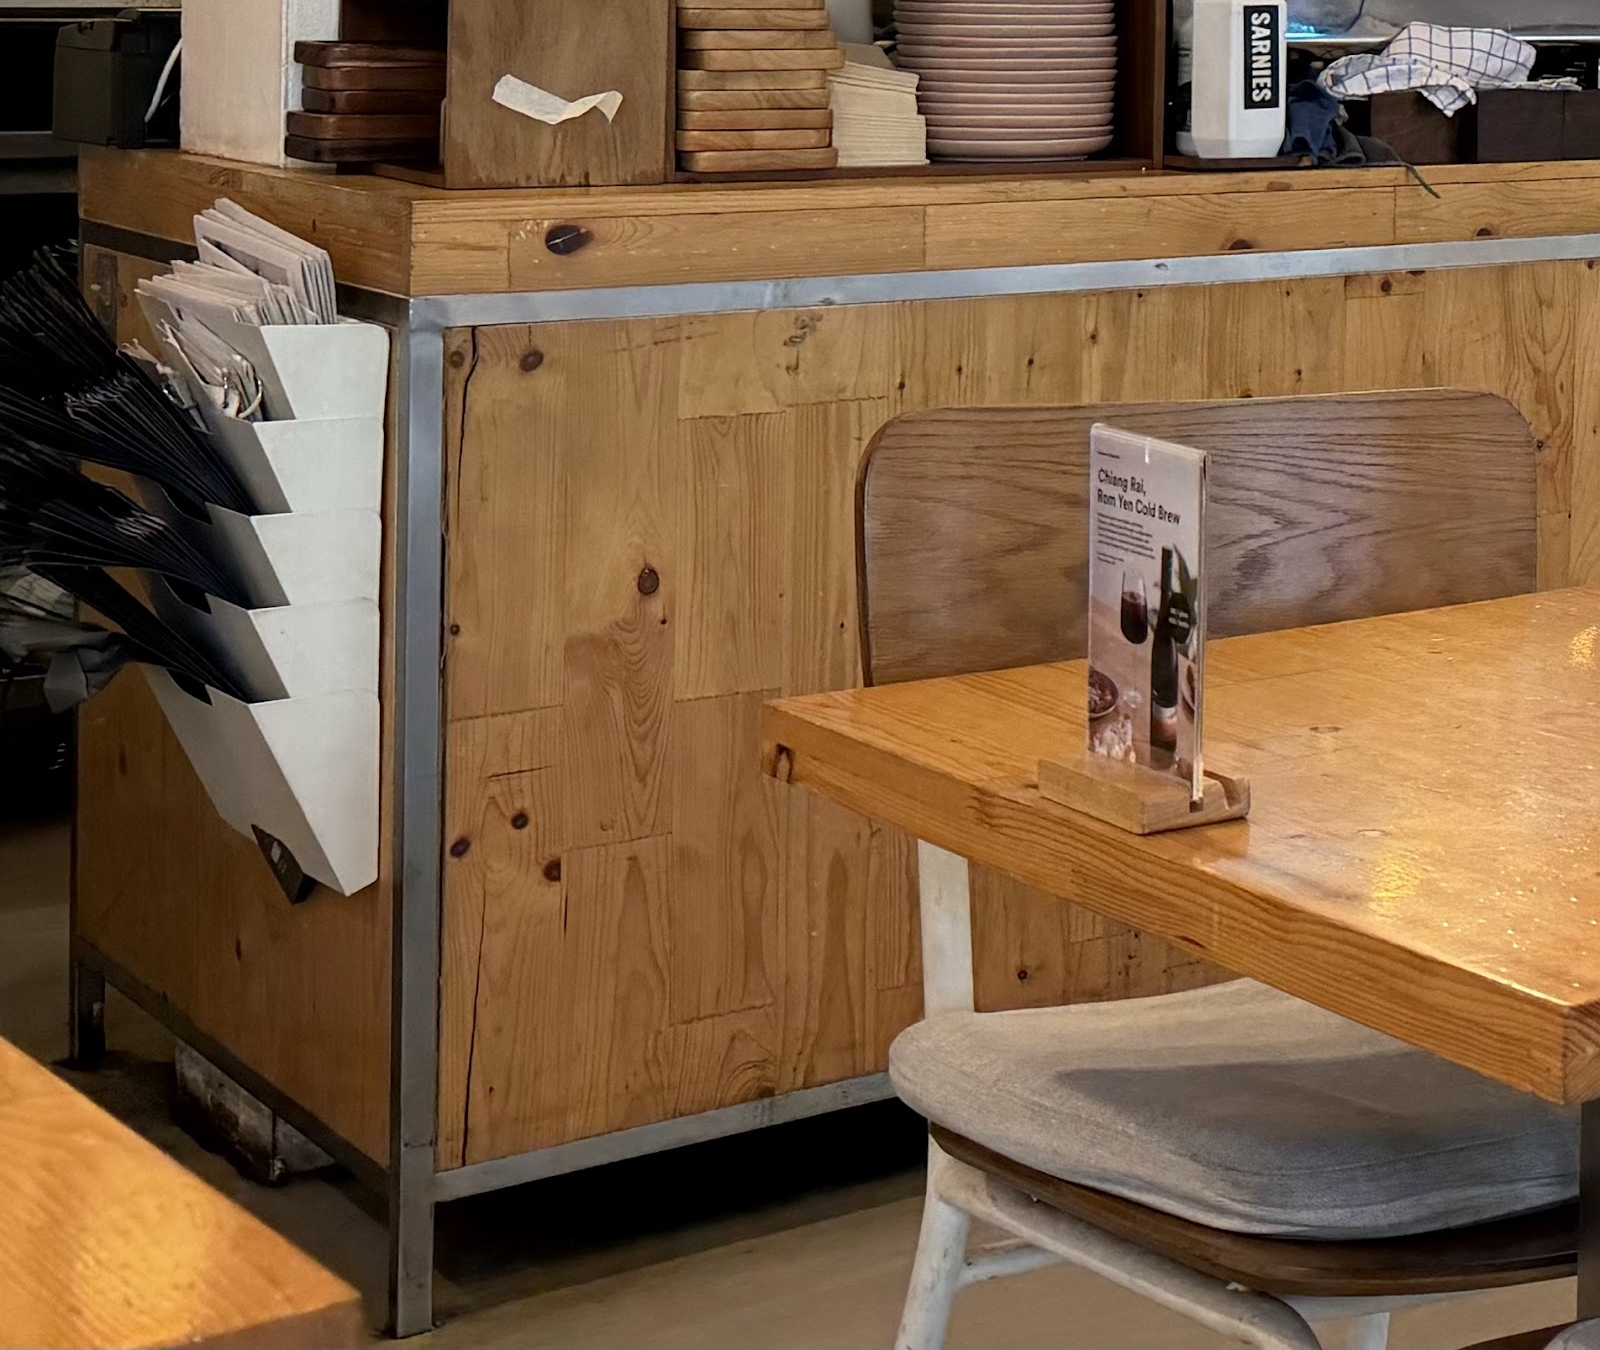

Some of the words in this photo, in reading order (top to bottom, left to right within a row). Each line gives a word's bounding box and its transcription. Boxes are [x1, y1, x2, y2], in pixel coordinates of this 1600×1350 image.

[1250, 11, 1272, 103] SARNIES
[1097, 467, 1128, 493] Chiang
[1130, 476, 1146, 497] Rai,
[1097, 488, 1116, 507] Rom
[1118, 493, 1134, 513] Yen
[1135, 498, 1156, 518] Cold
[1158, 505, 1181, 525] Brew
